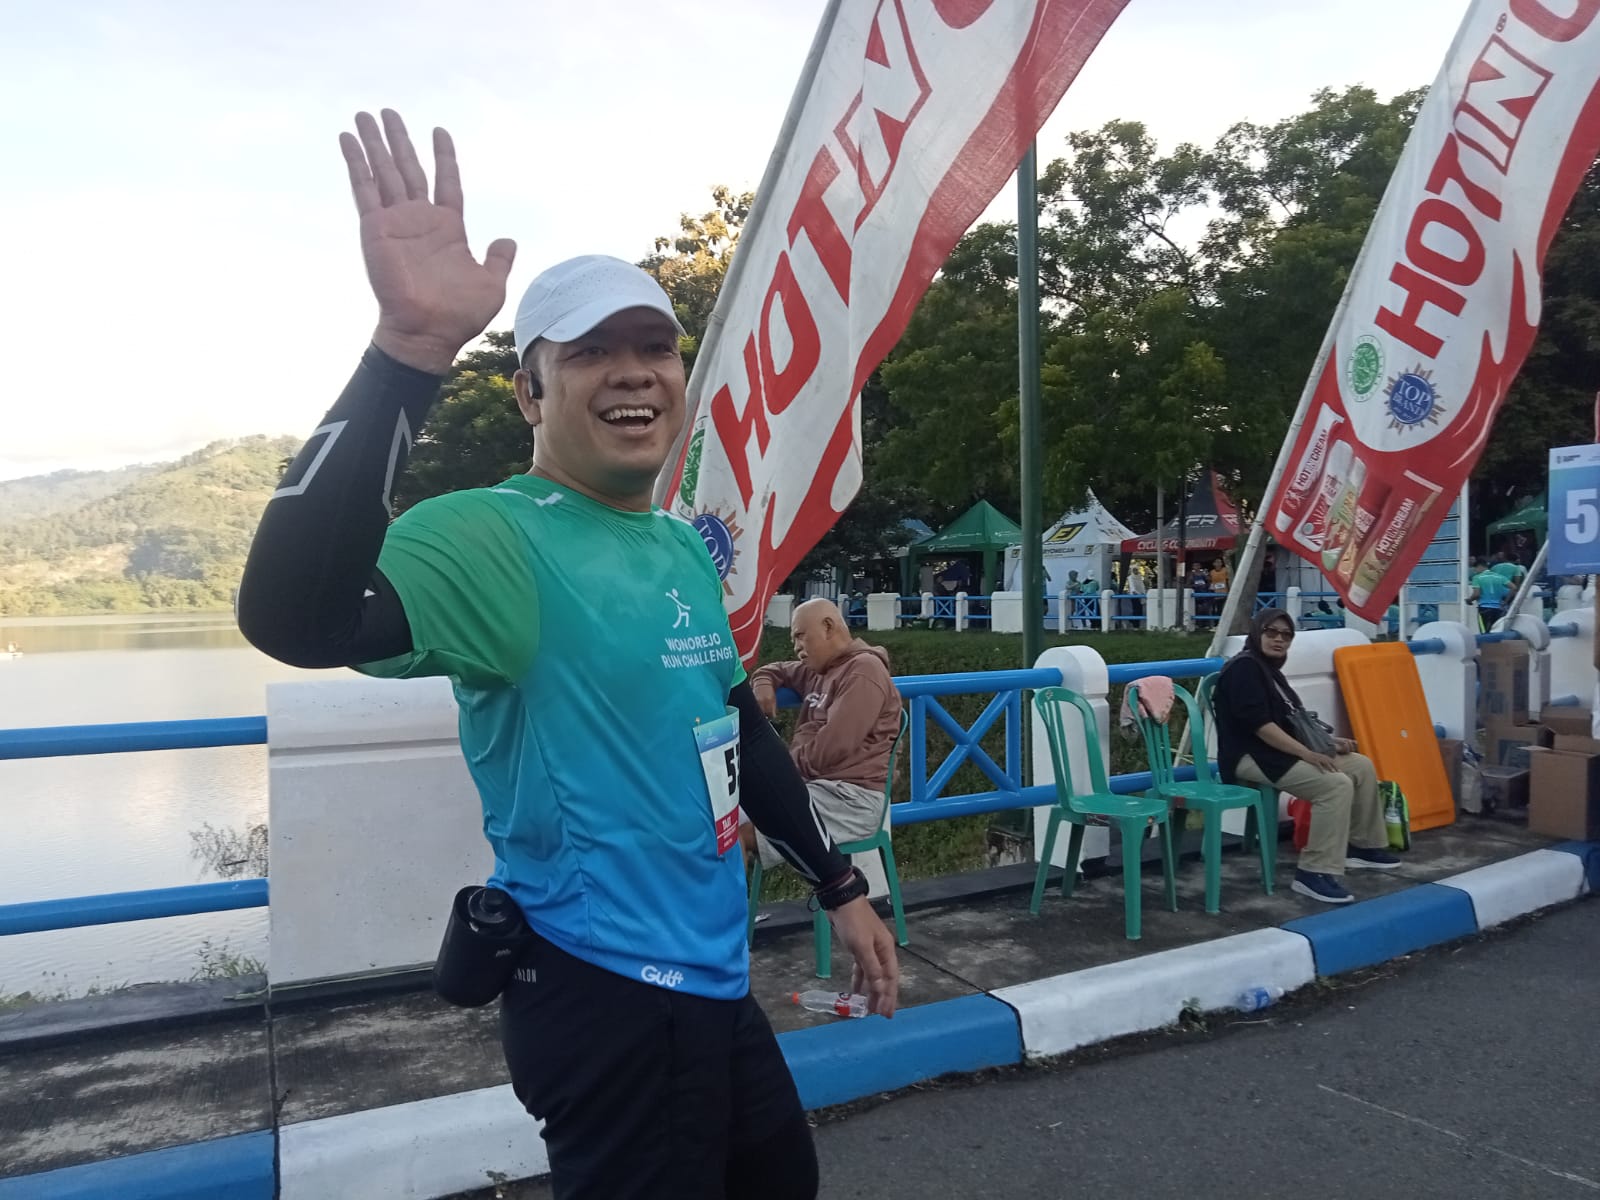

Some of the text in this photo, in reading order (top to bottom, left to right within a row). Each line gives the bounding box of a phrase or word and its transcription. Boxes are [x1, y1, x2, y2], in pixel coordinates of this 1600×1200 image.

[1399, 379, 1432, 405] TOP
[1565, 488, 1598, 544] 5
[665, 632, 721, 651] WONOREJO
[661, 646, 733, 668] RUN CHALLENGE
[724, 742, 740, 796] 5
